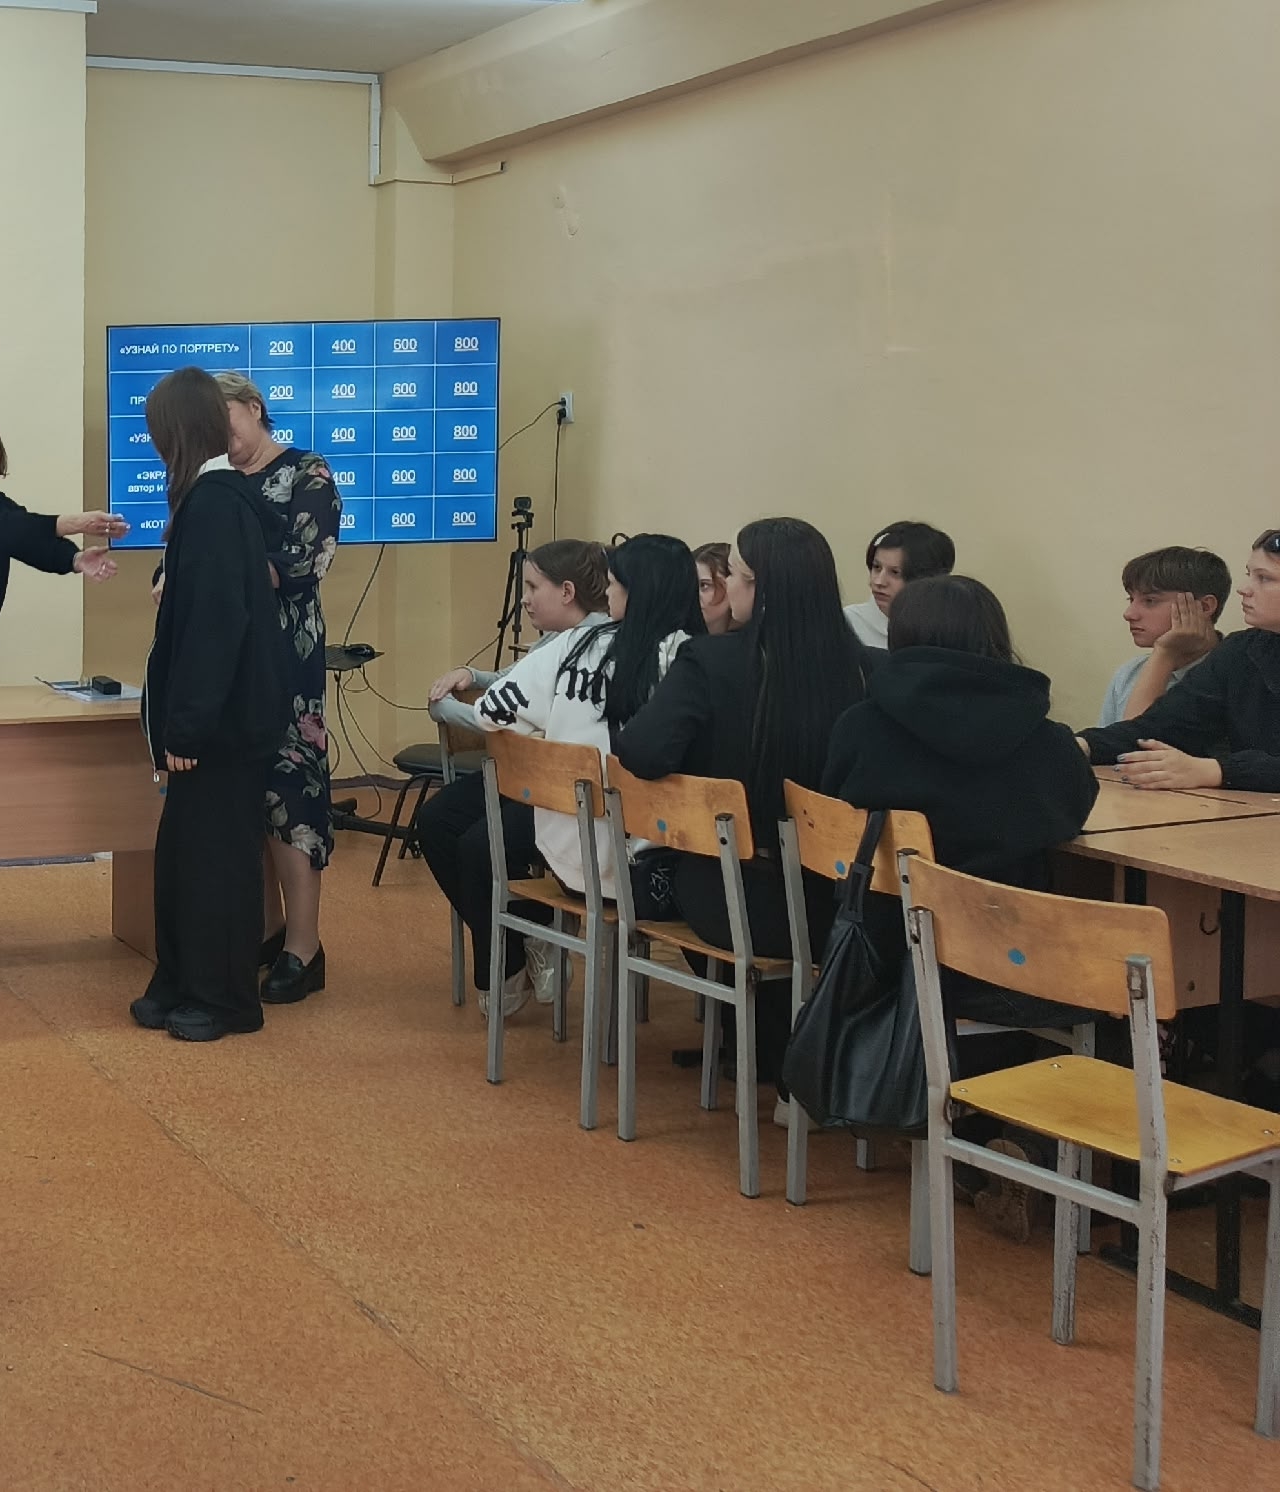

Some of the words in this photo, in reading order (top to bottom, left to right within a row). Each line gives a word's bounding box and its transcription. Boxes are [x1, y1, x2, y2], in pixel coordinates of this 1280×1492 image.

[120, 343, 159, 354] «УЗНАЙ
[162, 344, 177, 354] ПО
[180, 343, 240, 354] ПОРТРЕТУ»
[270, 341, 294, 354] 200
[332, 340, 355, 353] 400
[393, 339, 417, 351] 600
[455, 337, 478, 350] 800
[270, 386, 294, 398] 200
[332, 384, 355, 397] 400
[393, 383, 417, 396] 600
[454, 382, 478, 395] 800
[271, 430, 294, 441] 200
[332, 428, 355, 441] 400
[393, 427, 416, 439] 600
[454, 425, 477, 438] 800
[392, 470, 415, 483] 600
[453, 469, 477, 482] 800
[128, 485, 154, 493] автор
[157, 484, 163, 492] и
[392, 513, 415, 525] 600
[452, 511, 476, 524] 800
